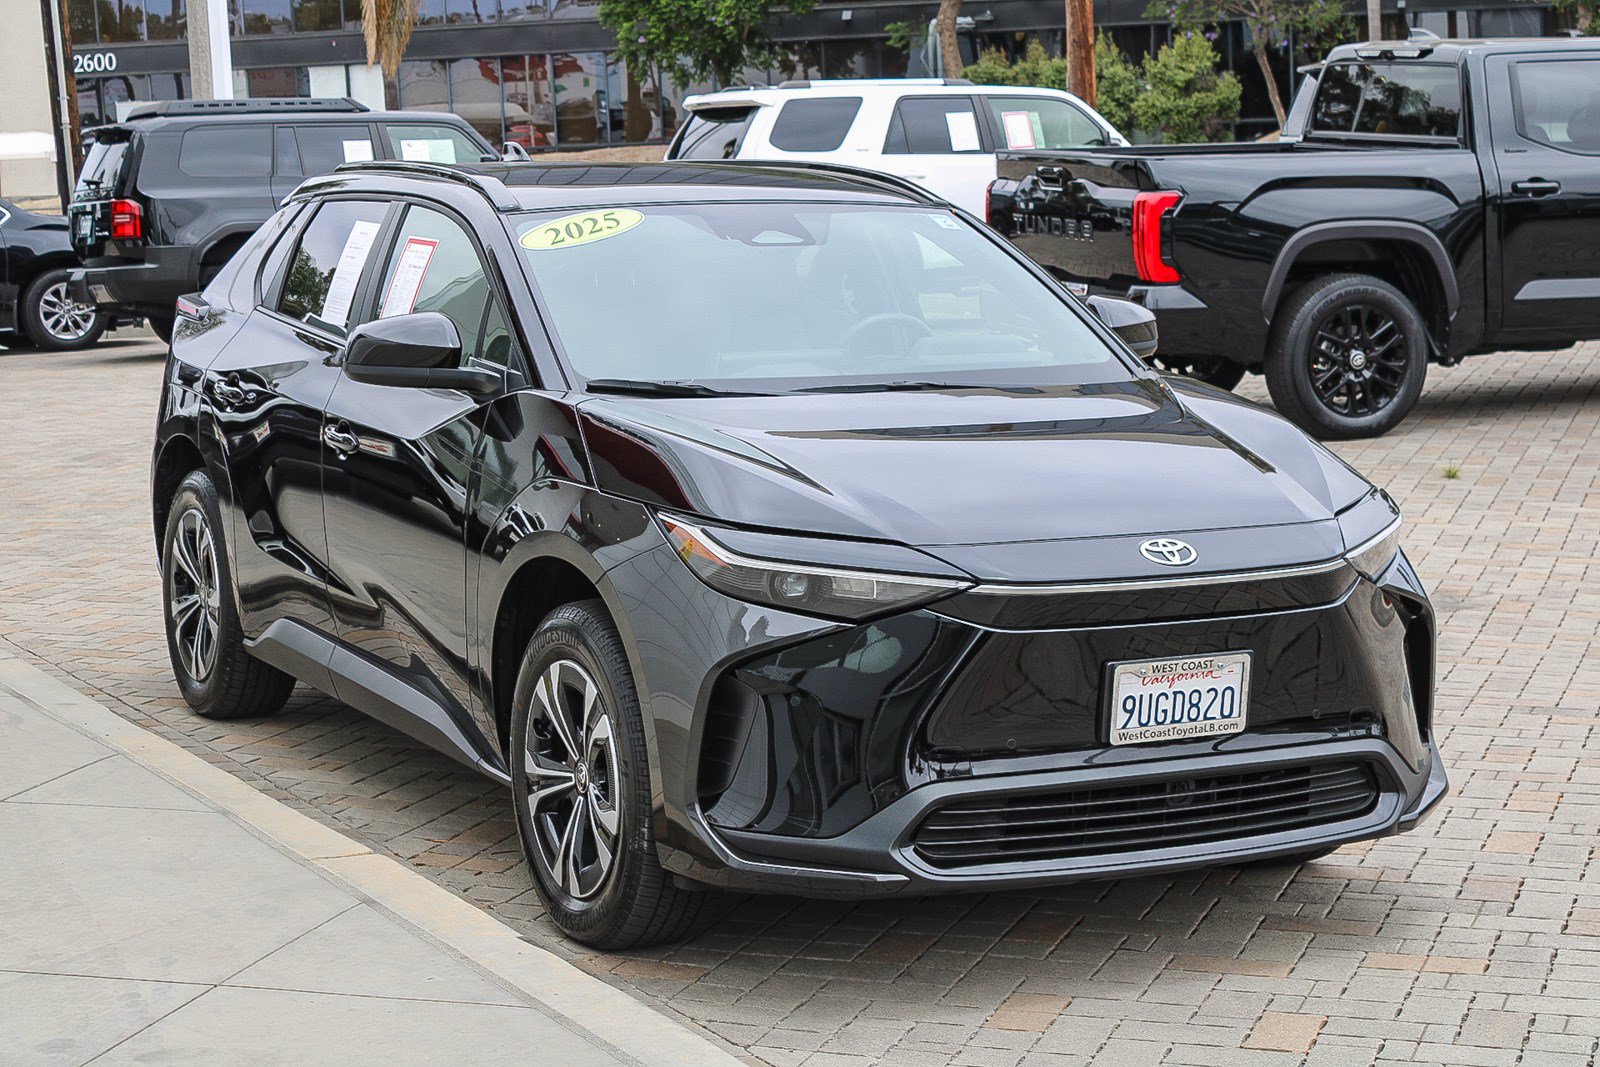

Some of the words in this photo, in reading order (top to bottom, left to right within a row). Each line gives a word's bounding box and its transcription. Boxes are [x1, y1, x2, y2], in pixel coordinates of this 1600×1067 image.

[73, 52, 117, 73] 2600
[544, 212, 621, 246] 2025
[1151, 662, 1180, 674] WEST
[1181, 659, 1214, 671] COAST
[1120, 685, 1236, 730] 9UGD820
[1118, 721, 1239, 742] WestCoastToyotaLB.com
